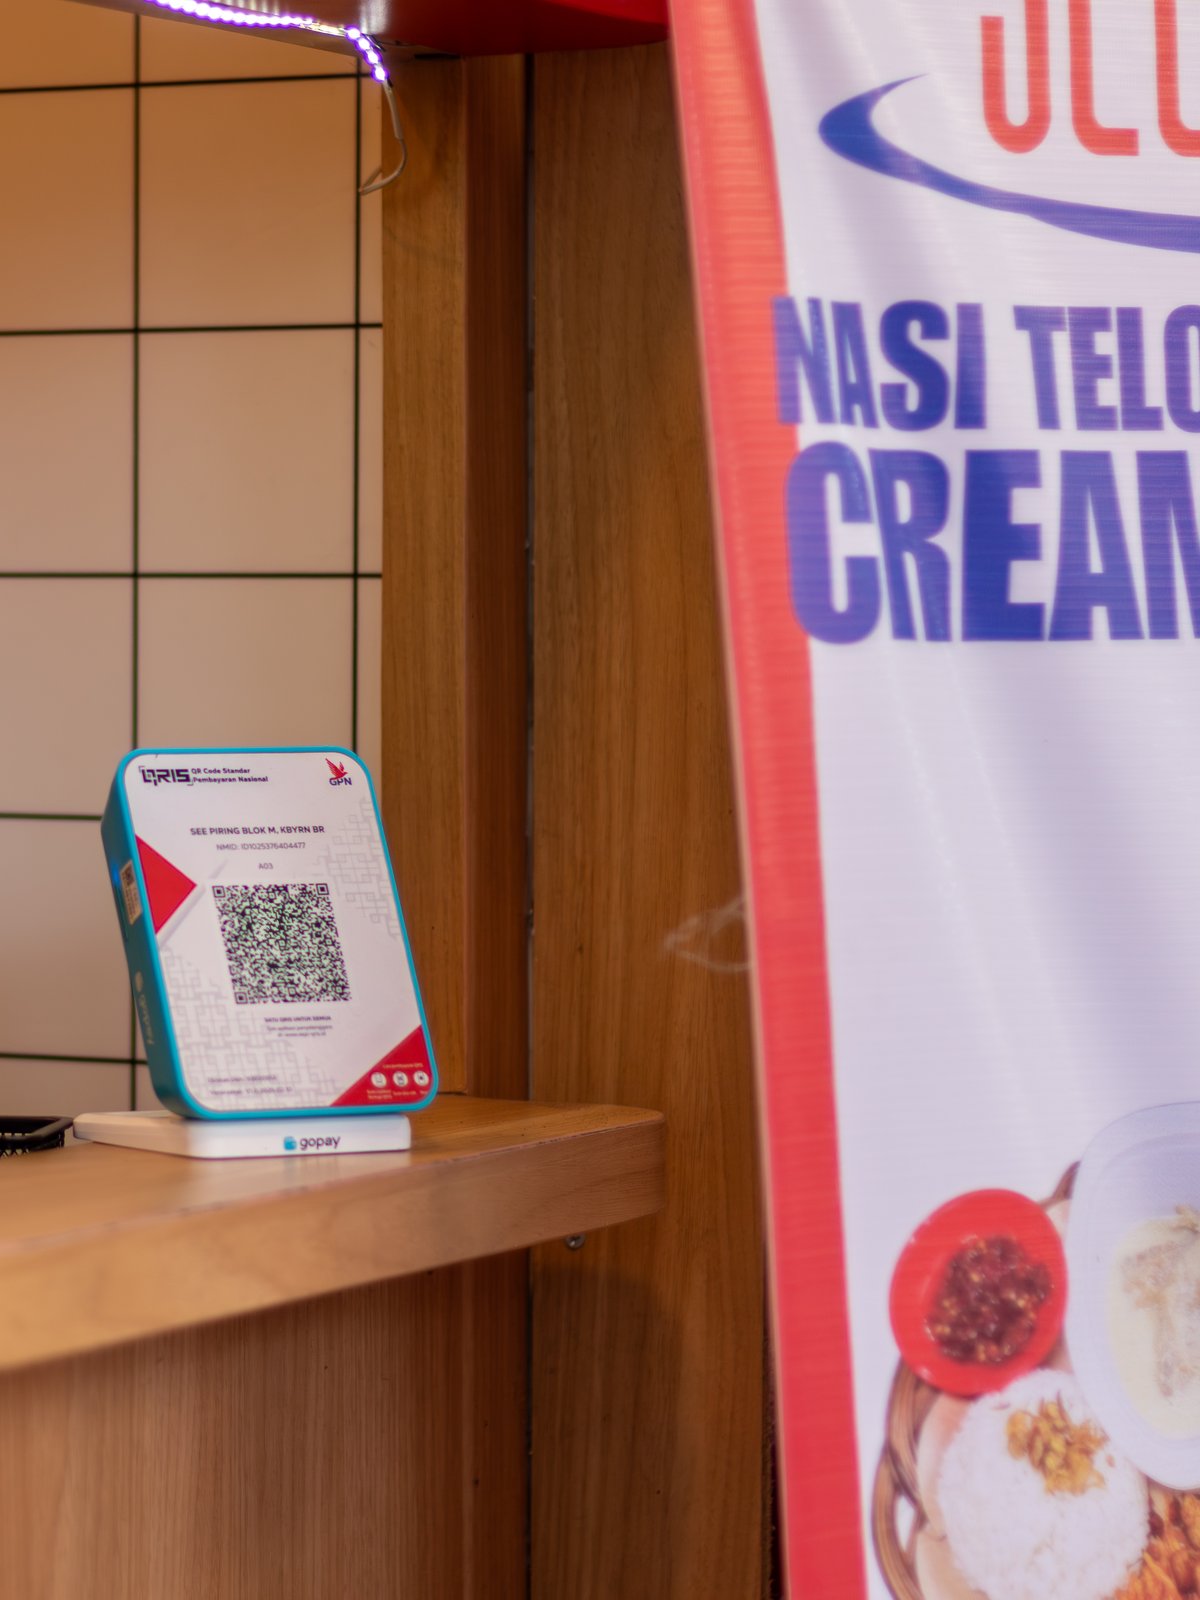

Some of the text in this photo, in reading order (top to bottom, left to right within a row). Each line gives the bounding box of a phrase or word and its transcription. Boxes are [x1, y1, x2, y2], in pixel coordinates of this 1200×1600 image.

[773, 295, 987, 432] NASI
[329, 777, 352, 786] GPN
[190, 827, 207, 835] SEE
[209, 827, 240, 835] PIRING
[241, 826, 266, 834] BLOK
[313, 825, 325, 834] BR
[300, 1136, 341, 1151] gopay
